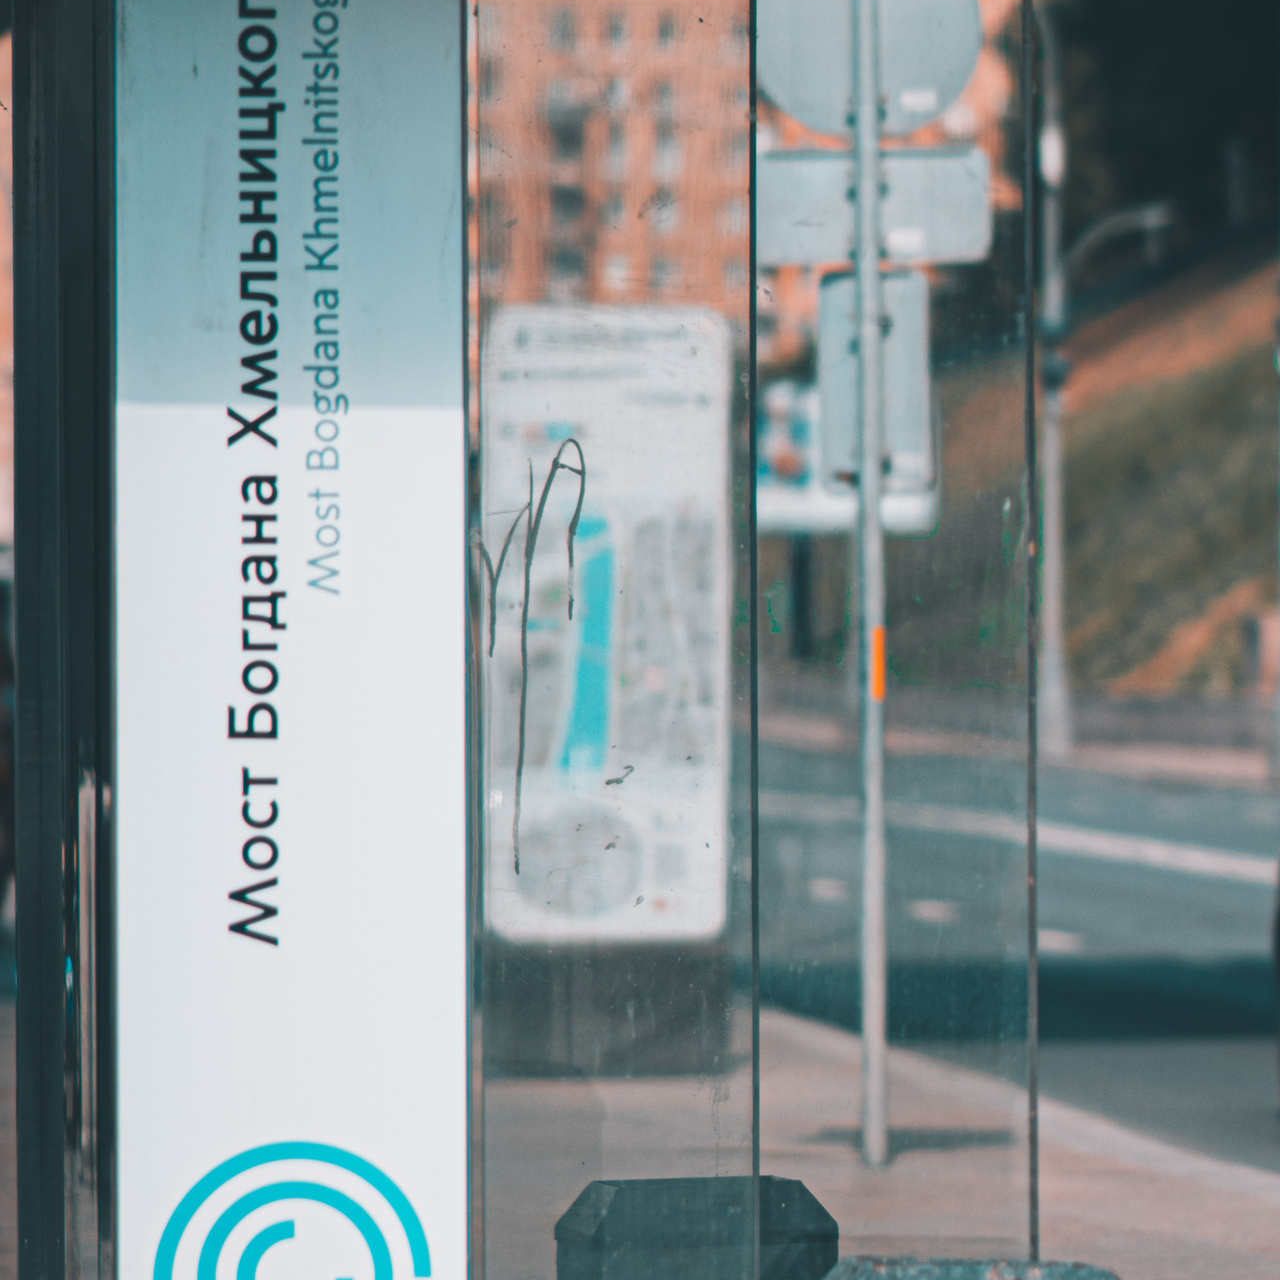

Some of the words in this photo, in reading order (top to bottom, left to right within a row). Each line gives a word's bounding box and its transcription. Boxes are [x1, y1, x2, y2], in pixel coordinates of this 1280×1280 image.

[302, 286, 349, 471] Bogdana
[226, 473, 287, 740] Богдана
[306, 486, 341, 596] Most
[227, 766, 280, 946] Мост
